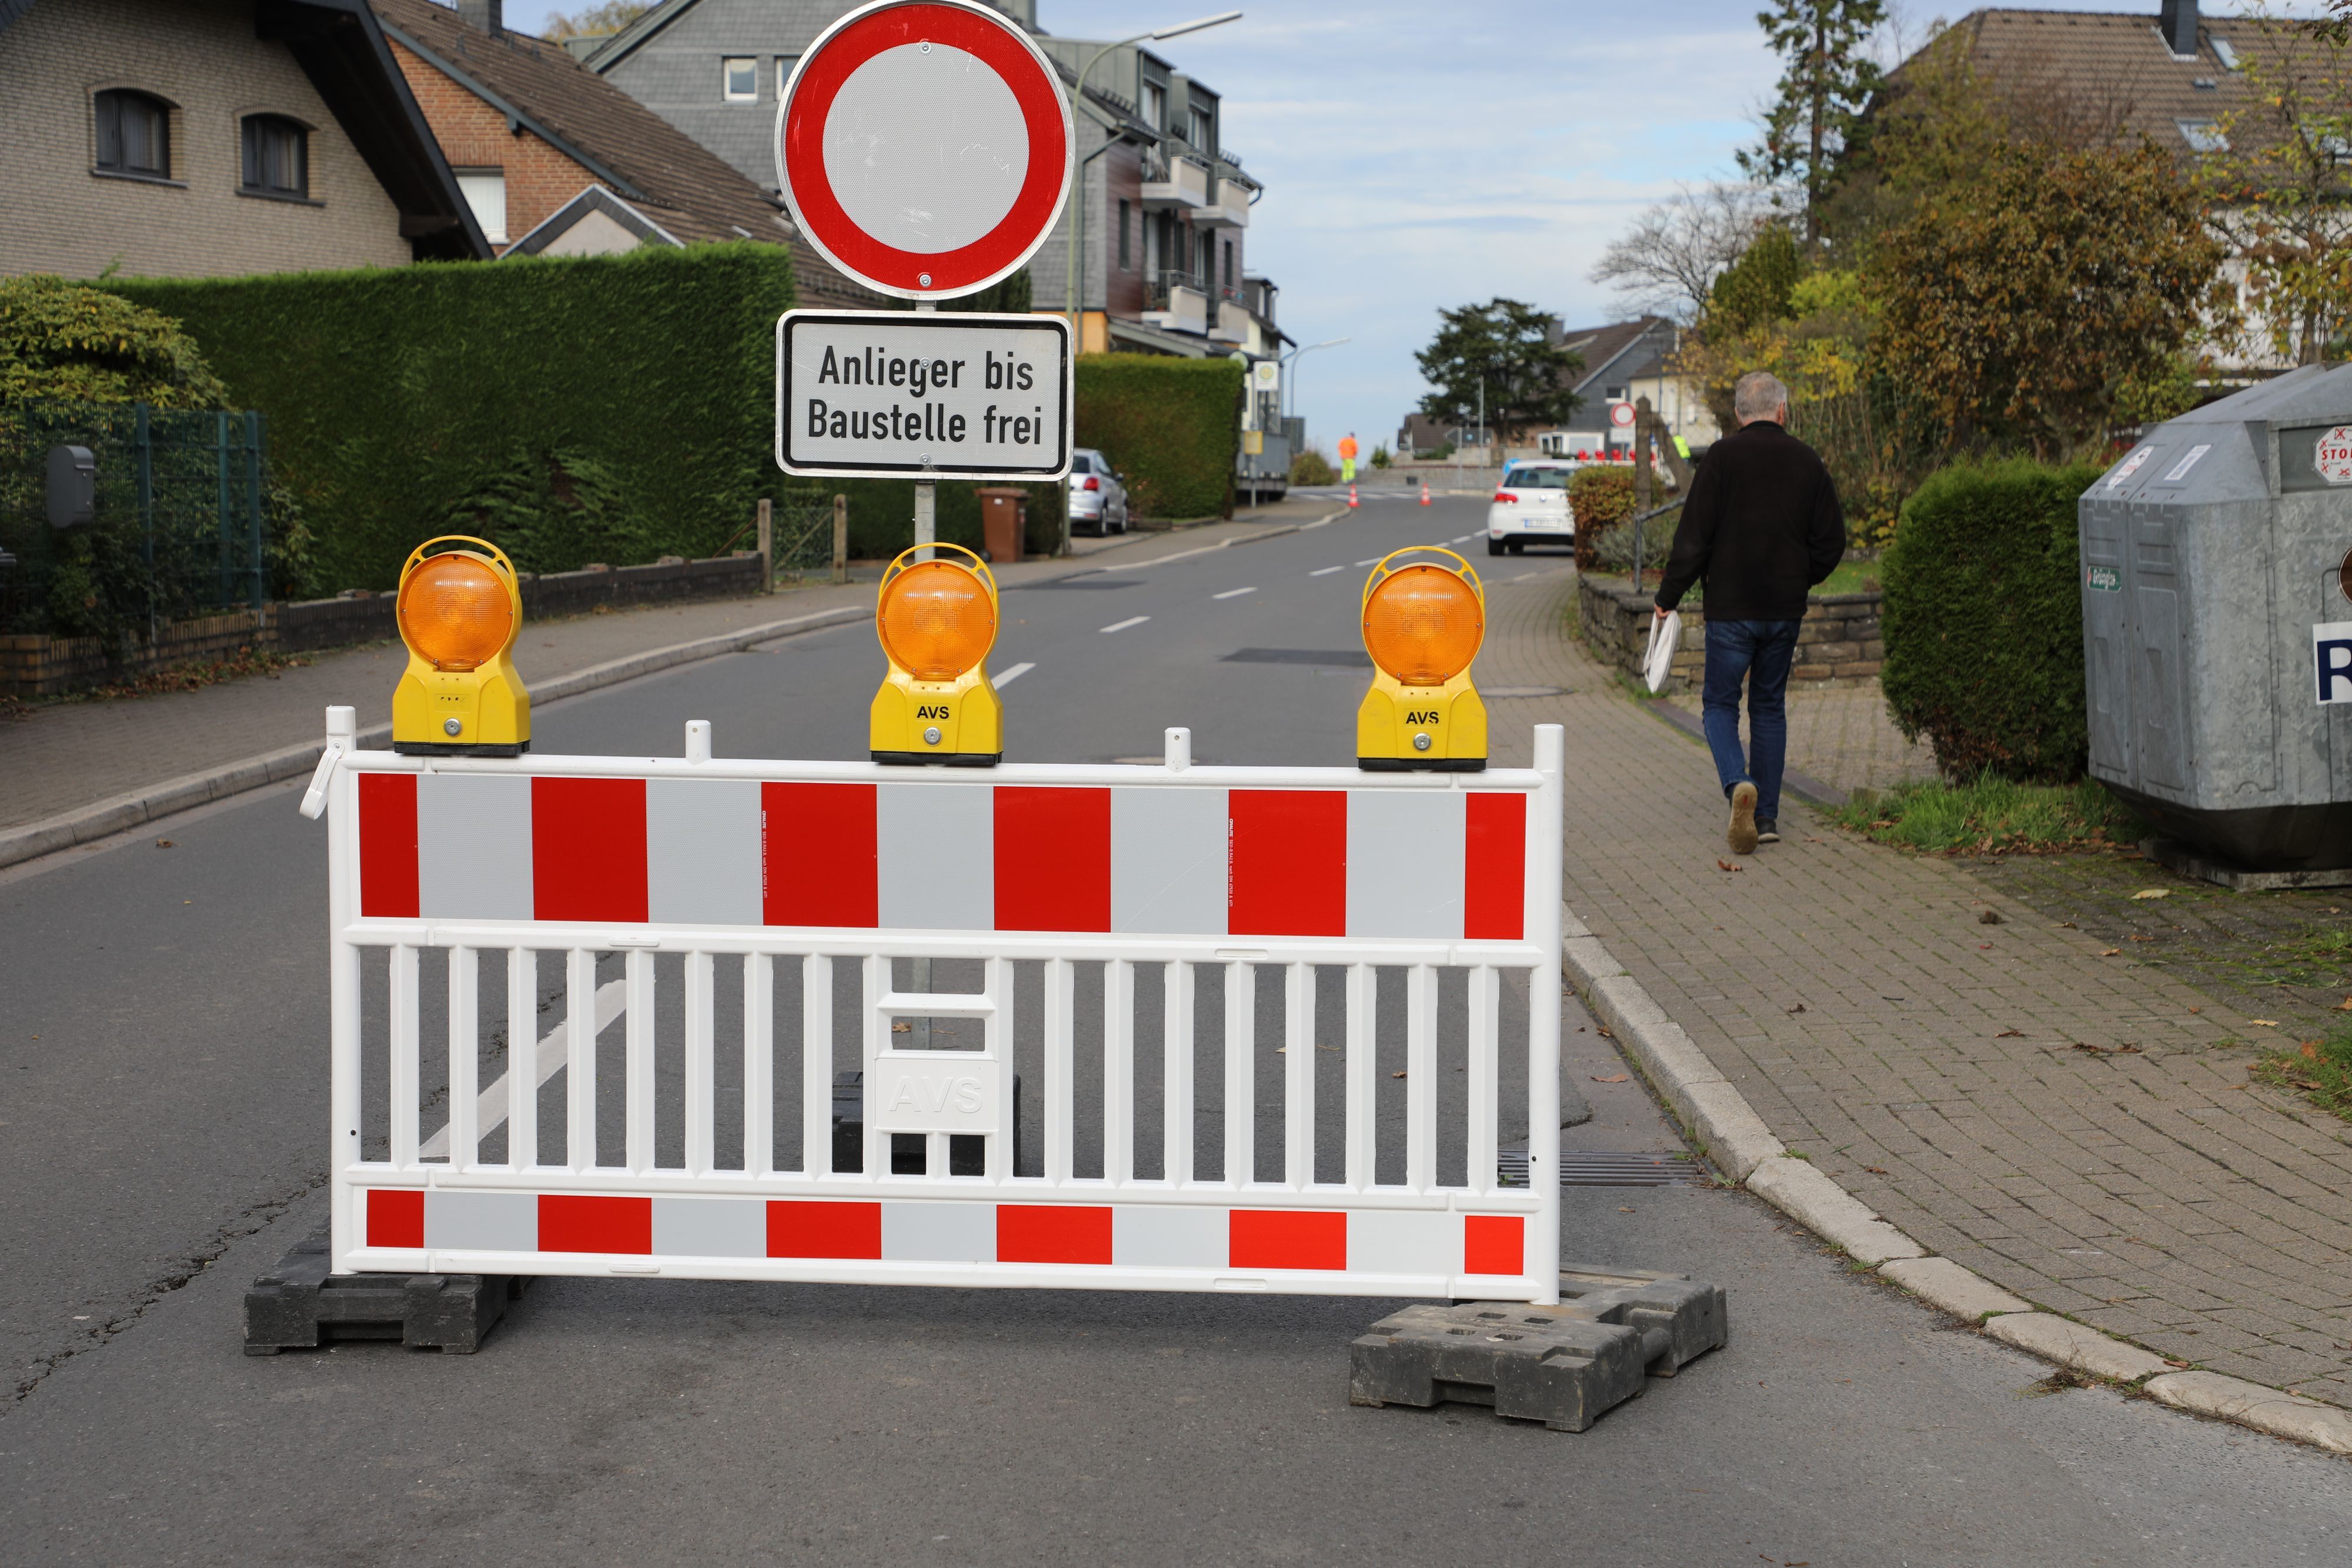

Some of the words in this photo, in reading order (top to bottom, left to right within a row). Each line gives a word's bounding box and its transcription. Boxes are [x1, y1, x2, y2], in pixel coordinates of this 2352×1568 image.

[818, 345, 965, 398] Anlieger
[985, 350, 1034, 391] bis
[807, 398, 967, 442] Baustelle
[983, 404, 1041, 445] frei
[2321, 448, 2352, 460] STO
[916, 705, 950, 720] AVS
[1405, 711, 1439, 725] AVS
[888, 1076, 983, 1114] AVS
